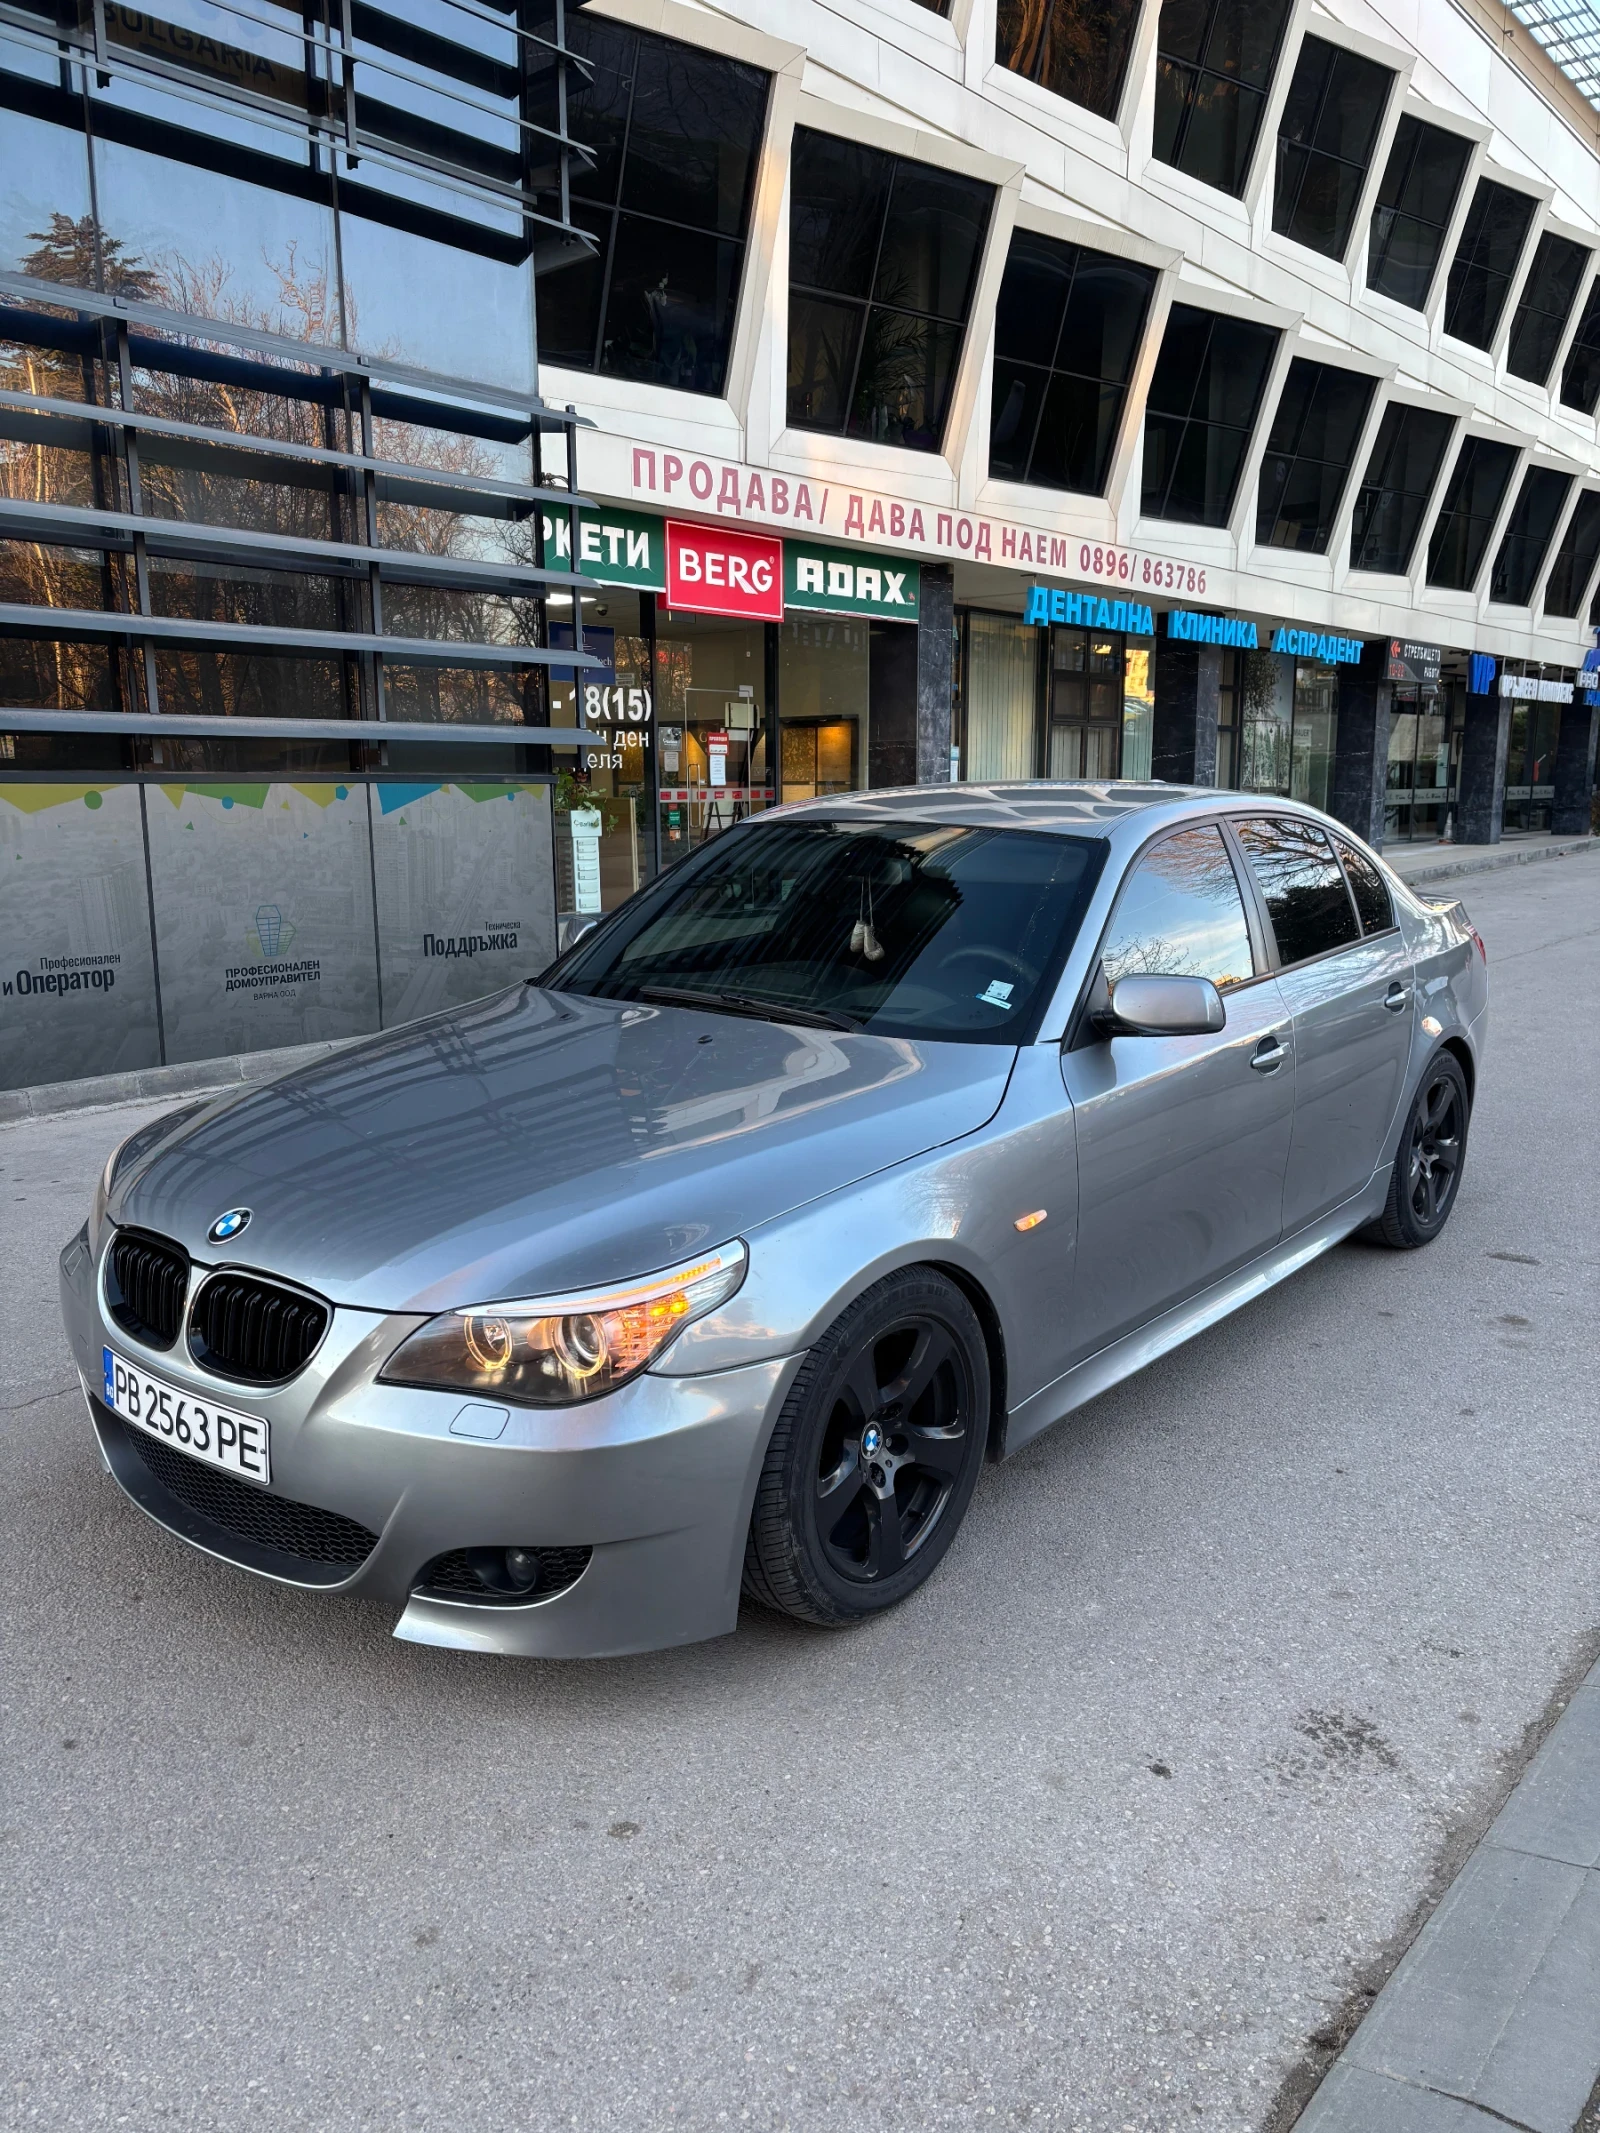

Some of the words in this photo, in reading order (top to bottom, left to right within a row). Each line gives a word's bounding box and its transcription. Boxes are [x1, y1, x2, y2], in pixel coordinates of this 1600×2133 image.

[844, 494, 926, 542] ДАВА
[937, 513, 992, 562] ПОД
[1002, 526, 1067, 568] НАЕМ
[1142, 557, 1207, 594] 863786
[679, 547, 773, 595] BERG
[796, 557, 906, 605] ADAX
[1024, 587, 1154, 635] ДЕНТАЛНА
[1168, 610, 1258, 649] КЛИНИКА
[1272, 628, 1364, 665] АСПРАДЕНТ
[1469, 653, 1495, 695] VIP
[613, 731, 649, 750] ден
[485, 921, 520, 931] Техническа
[423, 932, 518, 959] Поддръжка
[40, 954, 121, 971] Професионален
[225, 960, 320, 979] ПРОФЕСИОНАЛЕН
[2, 981, 13, 996] и
[16, 969, 115, 997] Оператор
[225, 971, 321, 992] ДОМОУПРАВИТЕЛ
[253, 991, 279, 1001] ВАРНА
